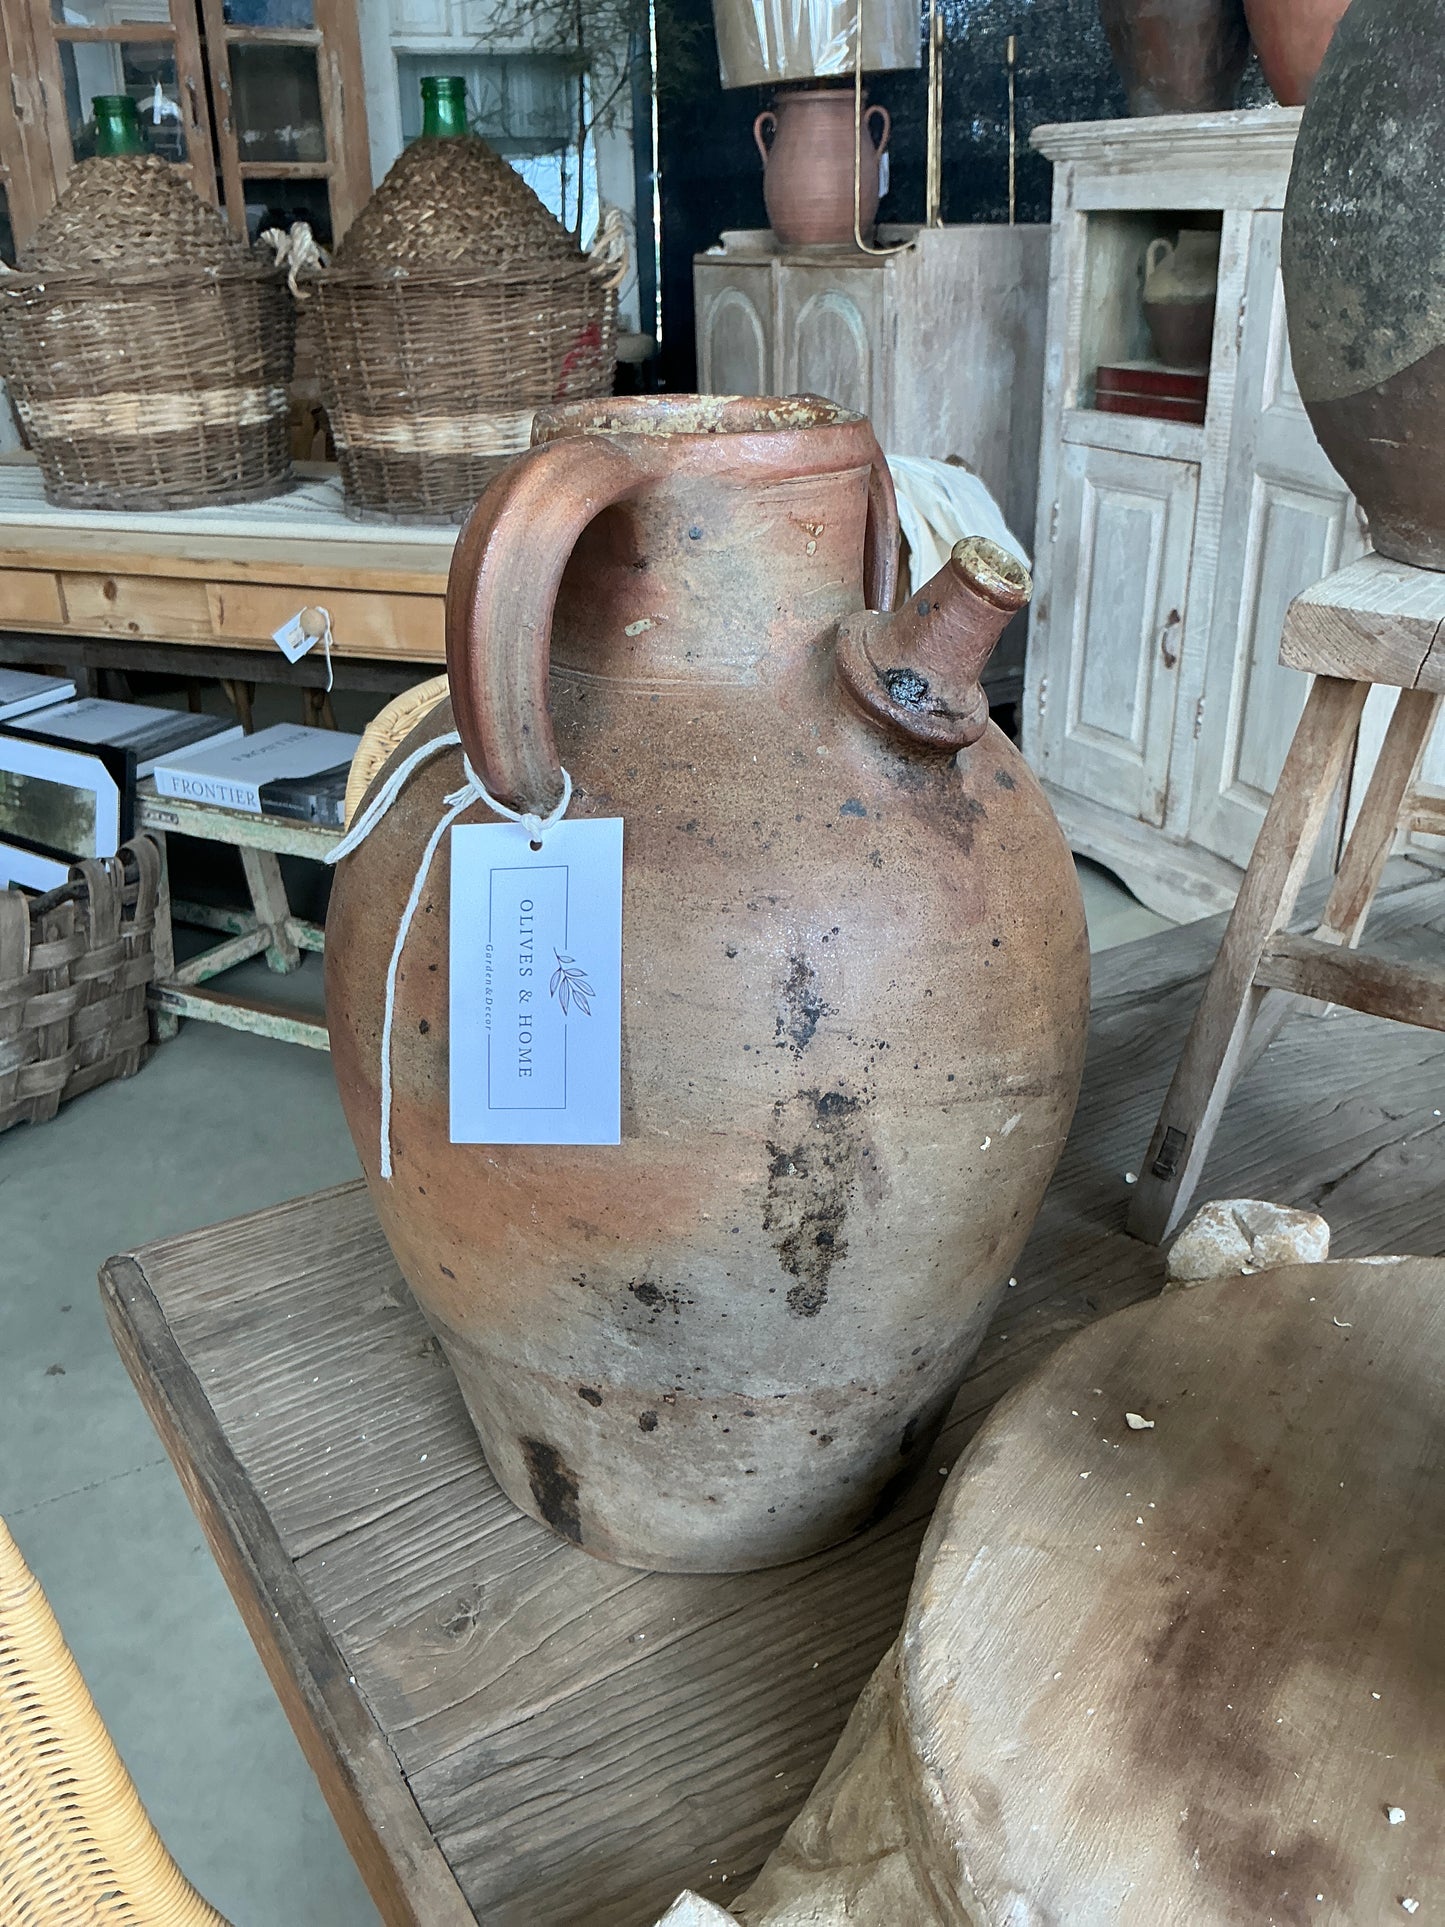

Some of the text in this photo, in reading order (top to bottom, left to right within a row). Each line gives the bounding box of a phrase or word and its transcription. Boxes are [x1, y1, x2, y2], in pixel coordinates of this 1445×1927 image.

[172, 777, 257, 807] FRONTIER
[518, 899, 534, 1078] OLIVES & HOME
